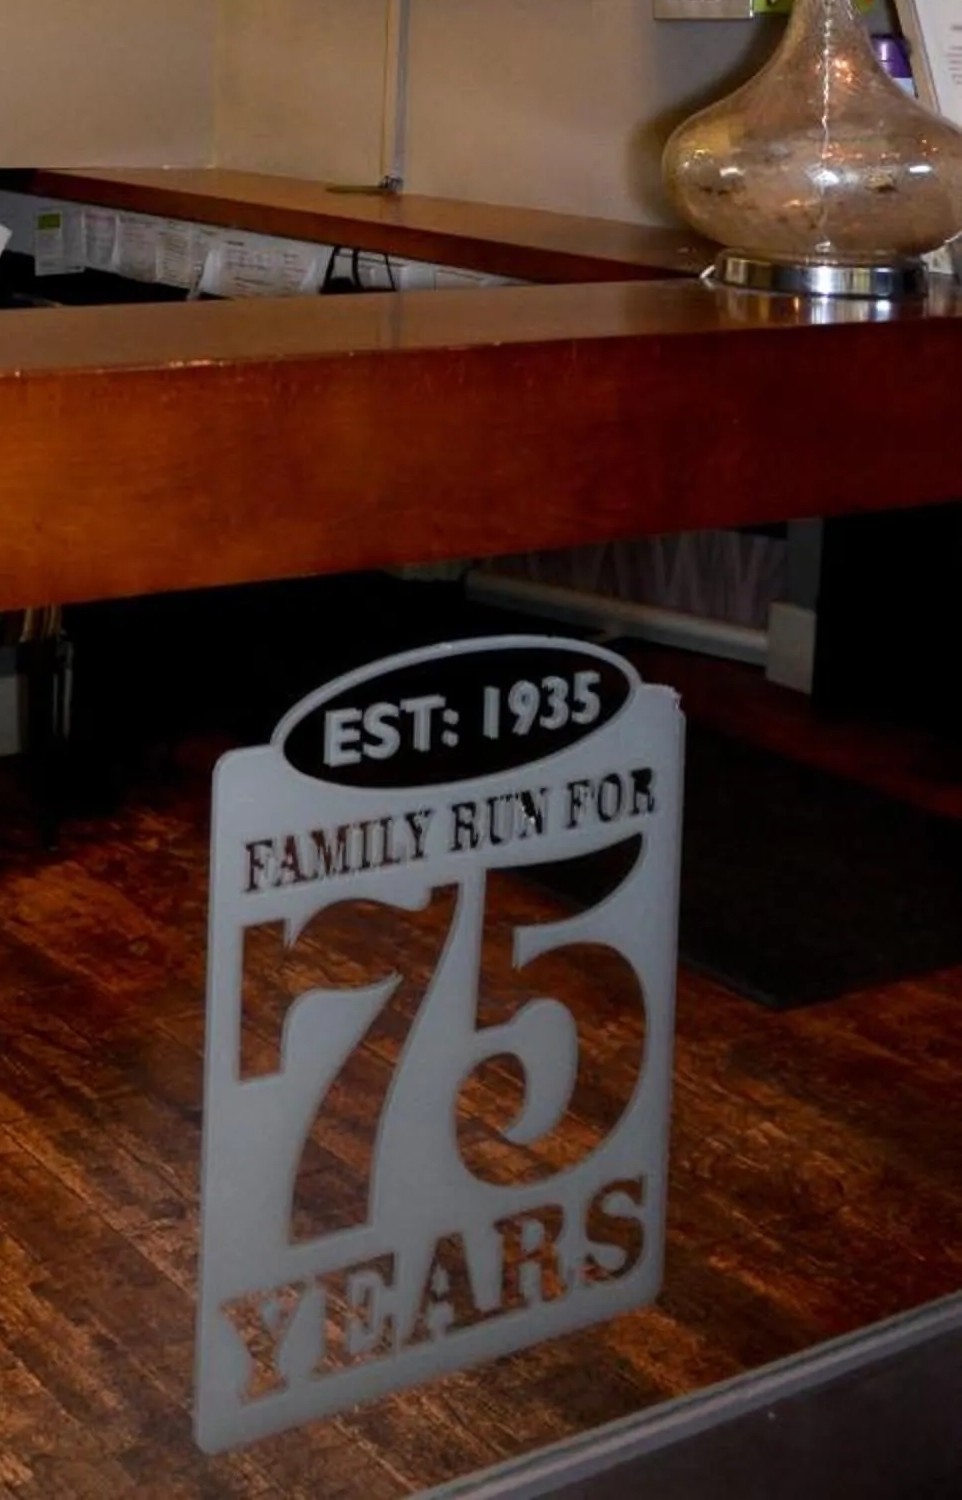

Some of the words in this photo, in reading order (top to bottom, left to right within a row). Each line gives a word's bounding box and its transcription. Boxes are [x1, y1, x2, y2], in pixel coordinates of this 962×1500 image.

[322, 694, 459, 768] EST:
[482, 670, 602, 740] 1935
[244, 808, 432, 893] FAMILY
[450, 787, 550, 853] RUN
[566, 766, 657, 831] FOR
[236, 833, 647, 1245] 75
[222, 1176, 646, 1399] YEARS
